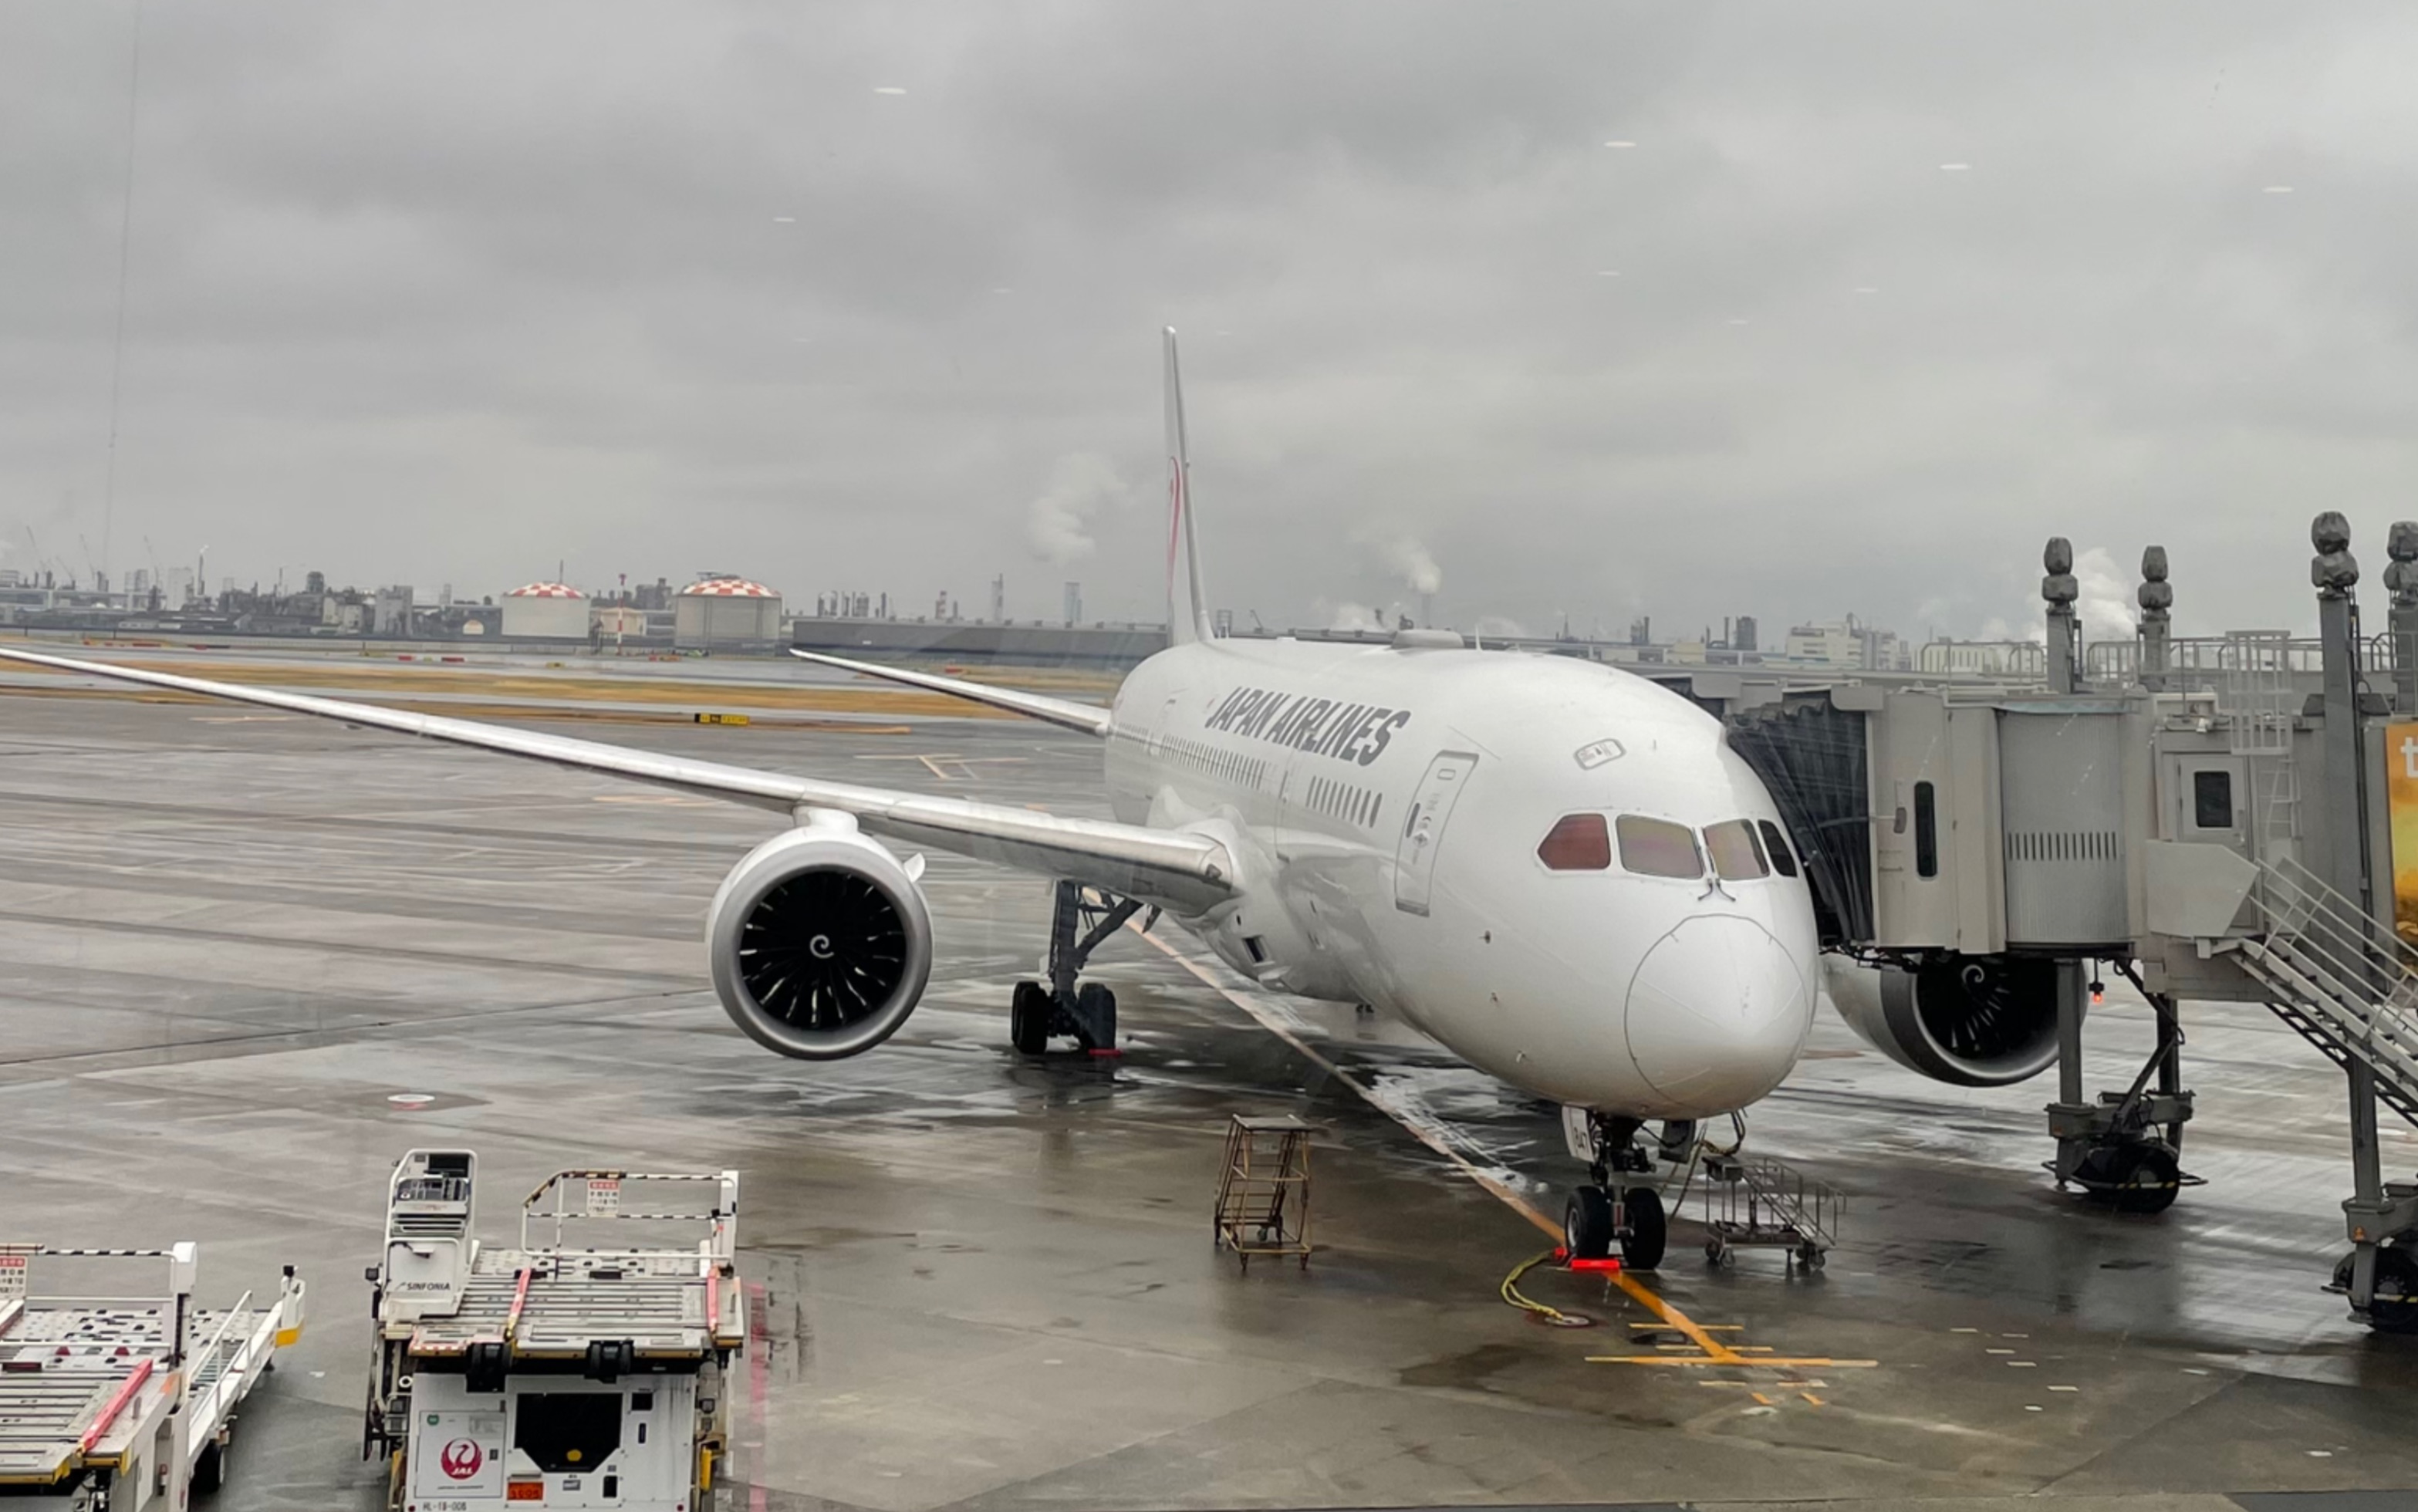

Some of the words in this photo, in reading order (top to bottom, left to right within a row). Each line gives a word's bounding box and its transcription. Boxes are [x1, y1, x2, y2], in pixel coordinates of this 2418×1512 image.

[1204, 686, 1292, 739] JAPAN
[1263, 696, 1411, 766] AIRLINES
[407, 1281, 451, 1291] SINFONIA
[451, 1466, 473, 1476] JAL
